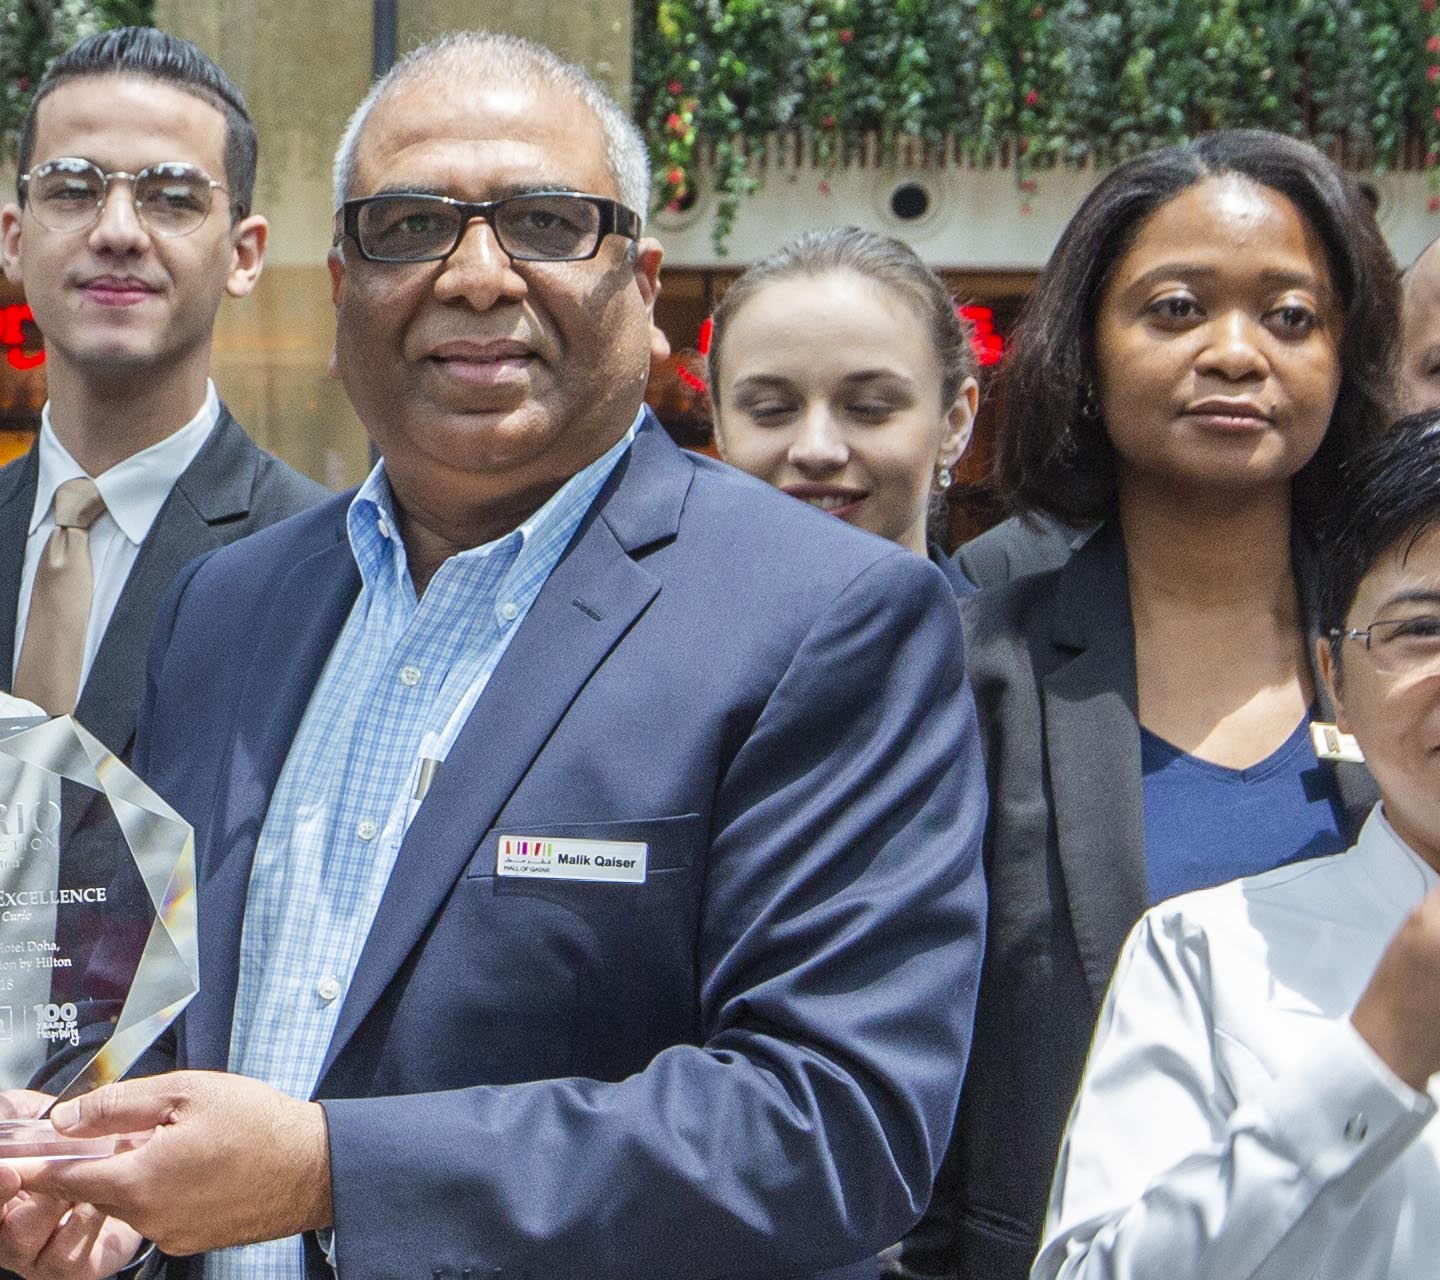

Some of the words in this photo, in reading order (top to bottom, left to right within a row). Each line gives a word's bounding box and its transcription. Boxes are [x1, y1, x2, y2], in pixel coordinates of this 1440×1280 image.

[557, 853, 591, 866] Malik
[594, 855, 637, 869] Qaiser
[2, 909, 33, 923] Curio
[27, 940, 61, 954] Doha,
[19, 958, 35, 973] by
[35, 956, 73, 969] Hilton
[32, 1003, 78, 1022] 100
